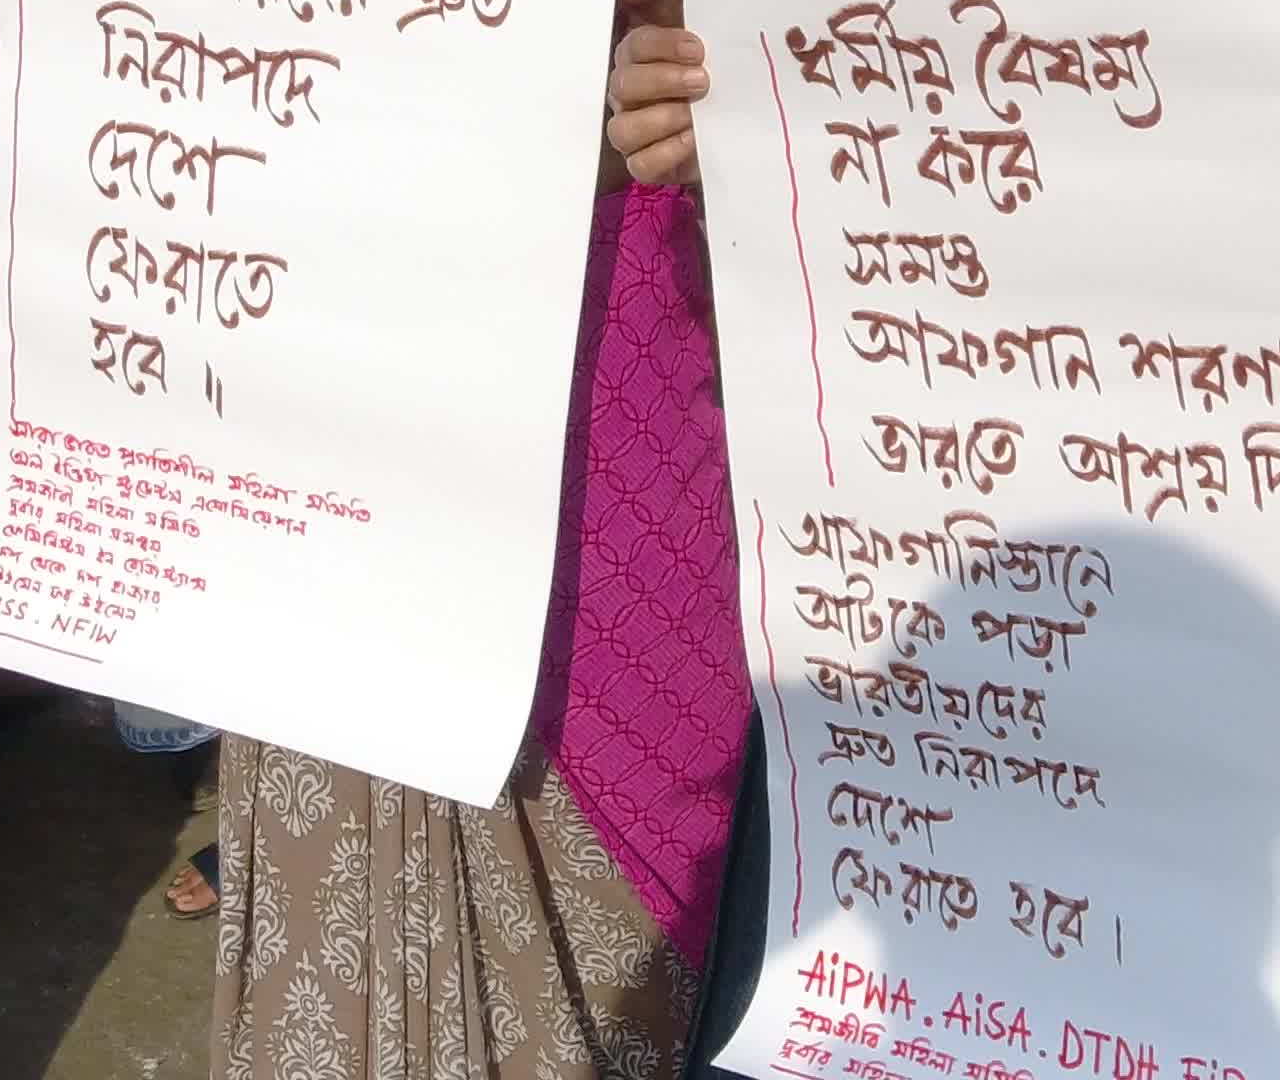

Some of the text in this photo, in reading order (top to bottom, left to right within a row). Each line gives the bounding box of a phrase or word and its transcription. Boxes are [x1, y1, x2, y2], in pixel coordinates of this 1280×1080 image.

[96, 1, 341, 127] নিরাপদে
[88, 119, 267, 216] দেশে
[825, 117, 1044, 214] না করে
[86, 226, 289, 329] ফেরাতে
[842, 224, 990, 298] সমস্ত
[844, 309, 1102, 395] আফগান
[861, 415, 1025, 495] ভারতে
[1059, 432, 1230, 523] আশ্রয়
[778, 509, 1114, 618] আফগানিস্তানে
[794, 572, 1088, 673] আটকে পড়া
[804, 655, 1049, 741] ভারতীয়দের
[818, 720, 1108, 810] দ্রুত নিরাপদে
[826, 781, 954, 855] দেশে
[831, 846, 980, 932] ফেরাতে
[890, 1036, 957, 1075] মহিলা
